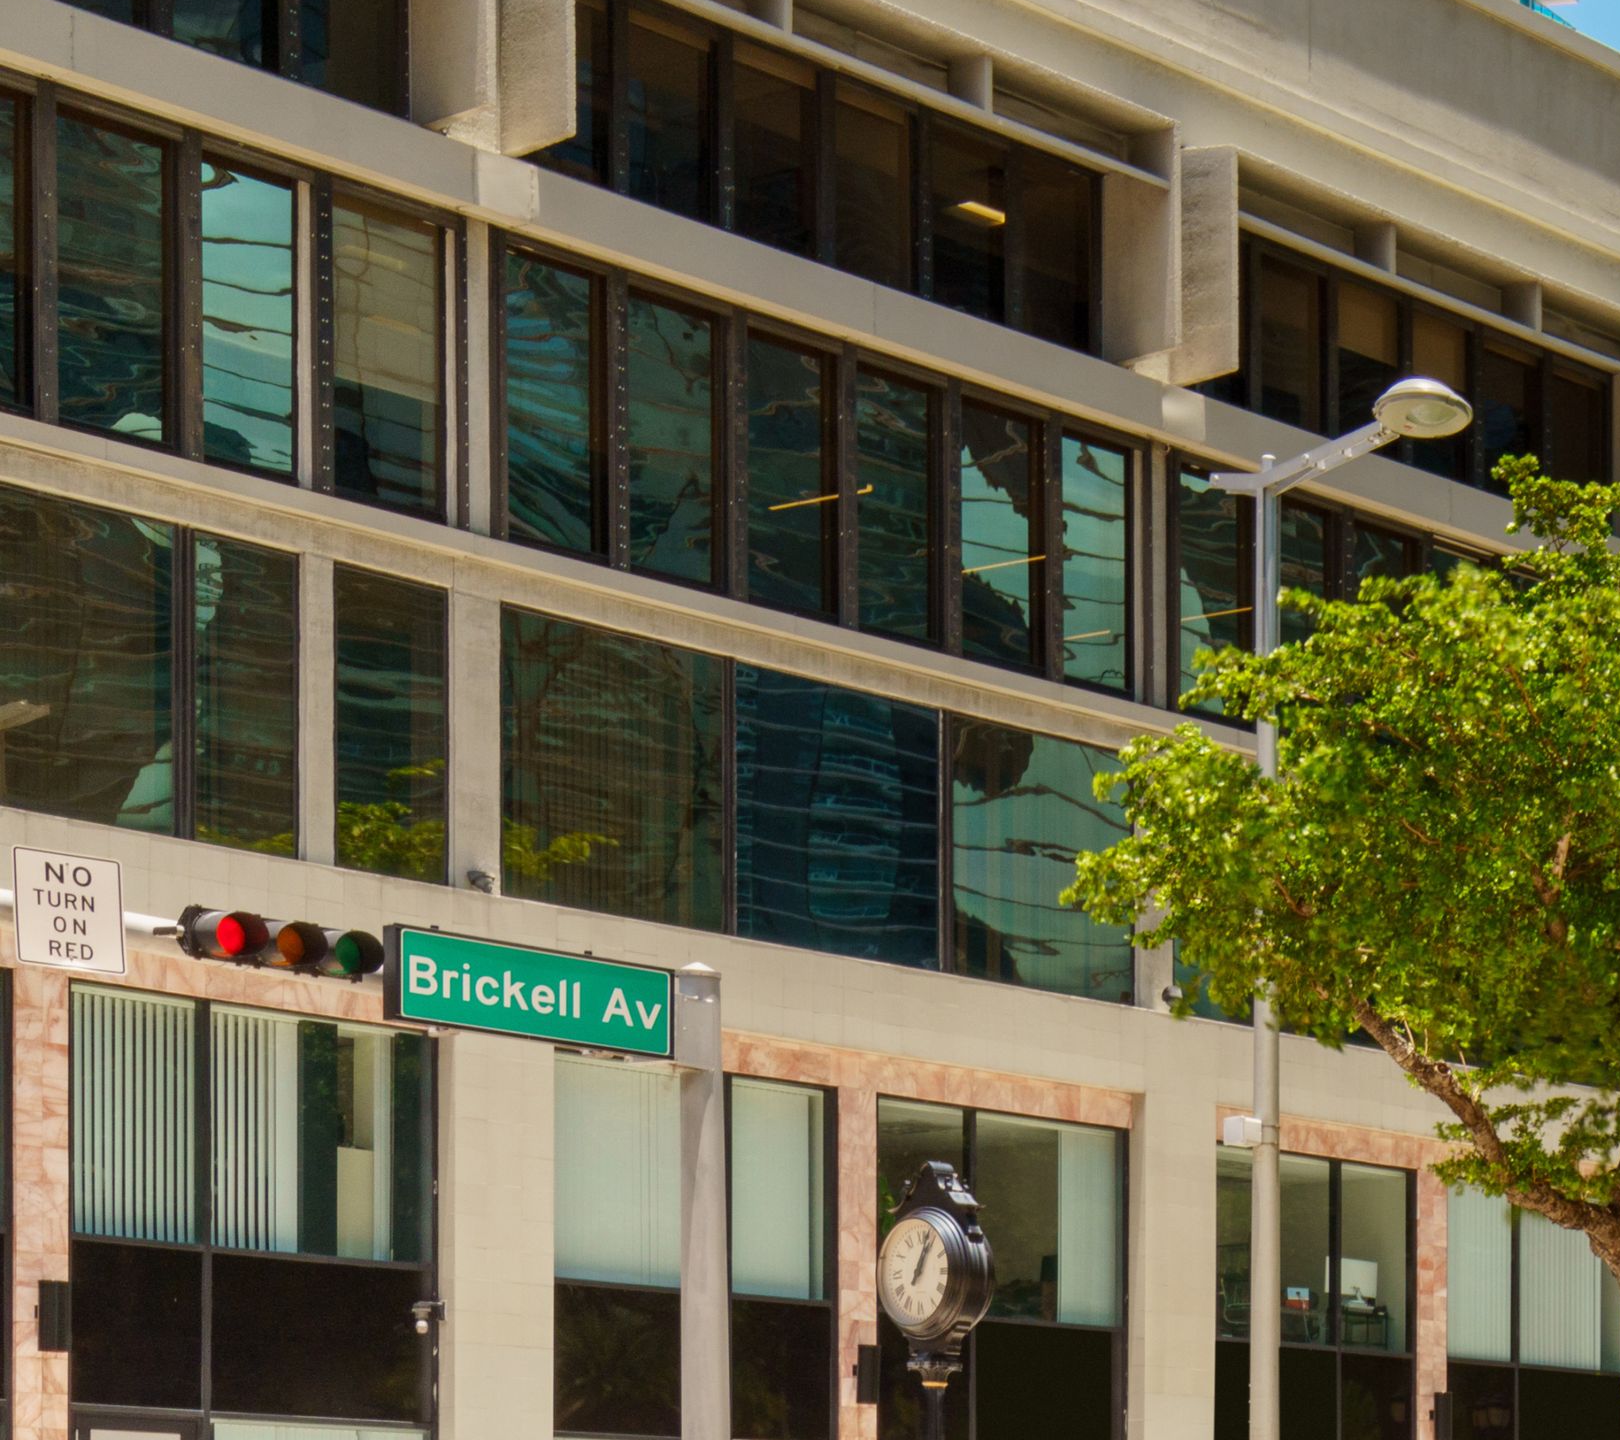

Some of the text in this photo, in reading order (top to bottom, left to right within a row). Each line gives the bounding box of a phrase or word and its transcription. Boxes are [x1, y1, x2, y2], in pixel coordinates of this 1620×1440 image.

[45, 861, 92, 887] NO
[33, 888, 95, 912] TURN
[53, 916, 87, 936] ON
[49, 939, 94, 961] RED
[409, 954, 662, 1030] Brickell Av
